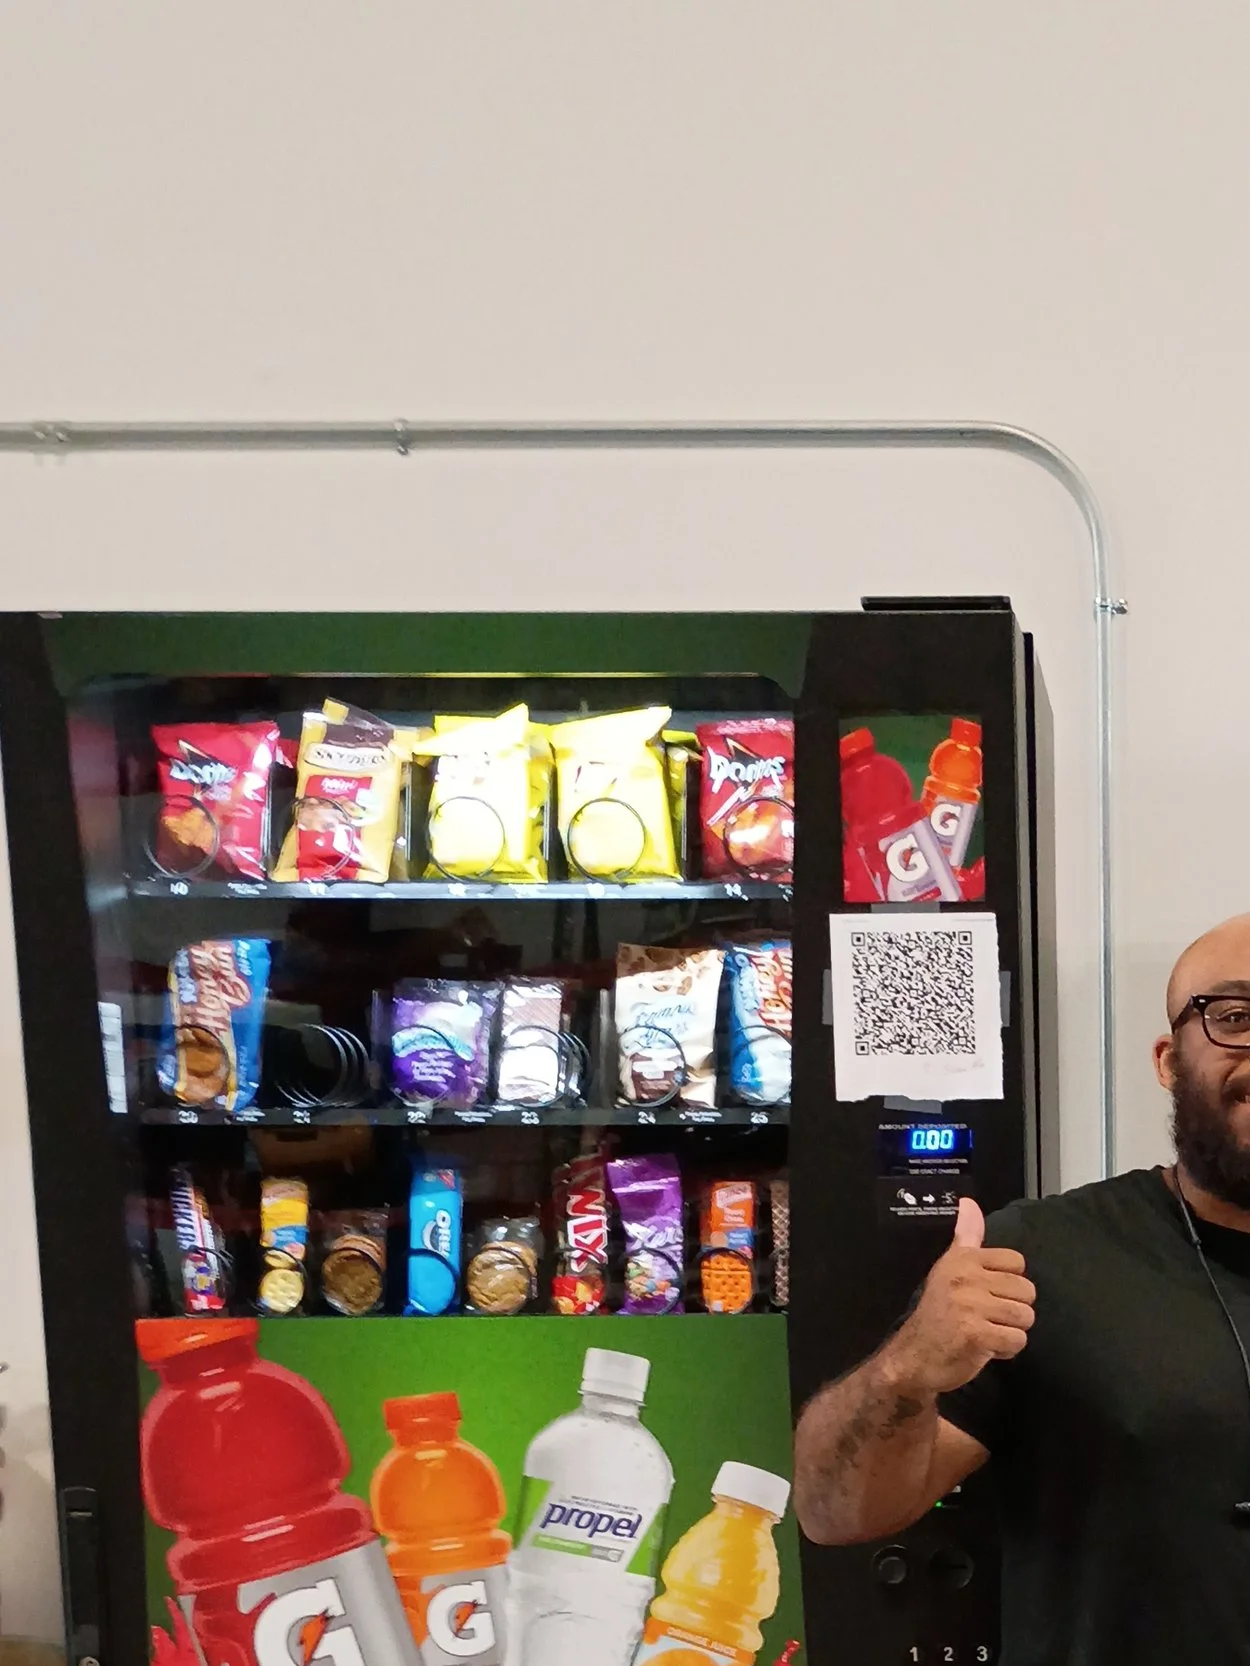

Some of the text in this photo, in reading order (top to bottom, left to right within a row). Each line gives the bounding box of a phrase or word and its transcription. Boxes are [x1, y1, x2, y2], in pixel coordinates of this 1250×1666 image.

[931, 804, 963, 836] G
[886, 833, 930, 882] G
[538, 1502, 643, 1539] propel
[426, 1580, 496, 1656] G
[909, 1645, 988, 1662] 1 2 3
